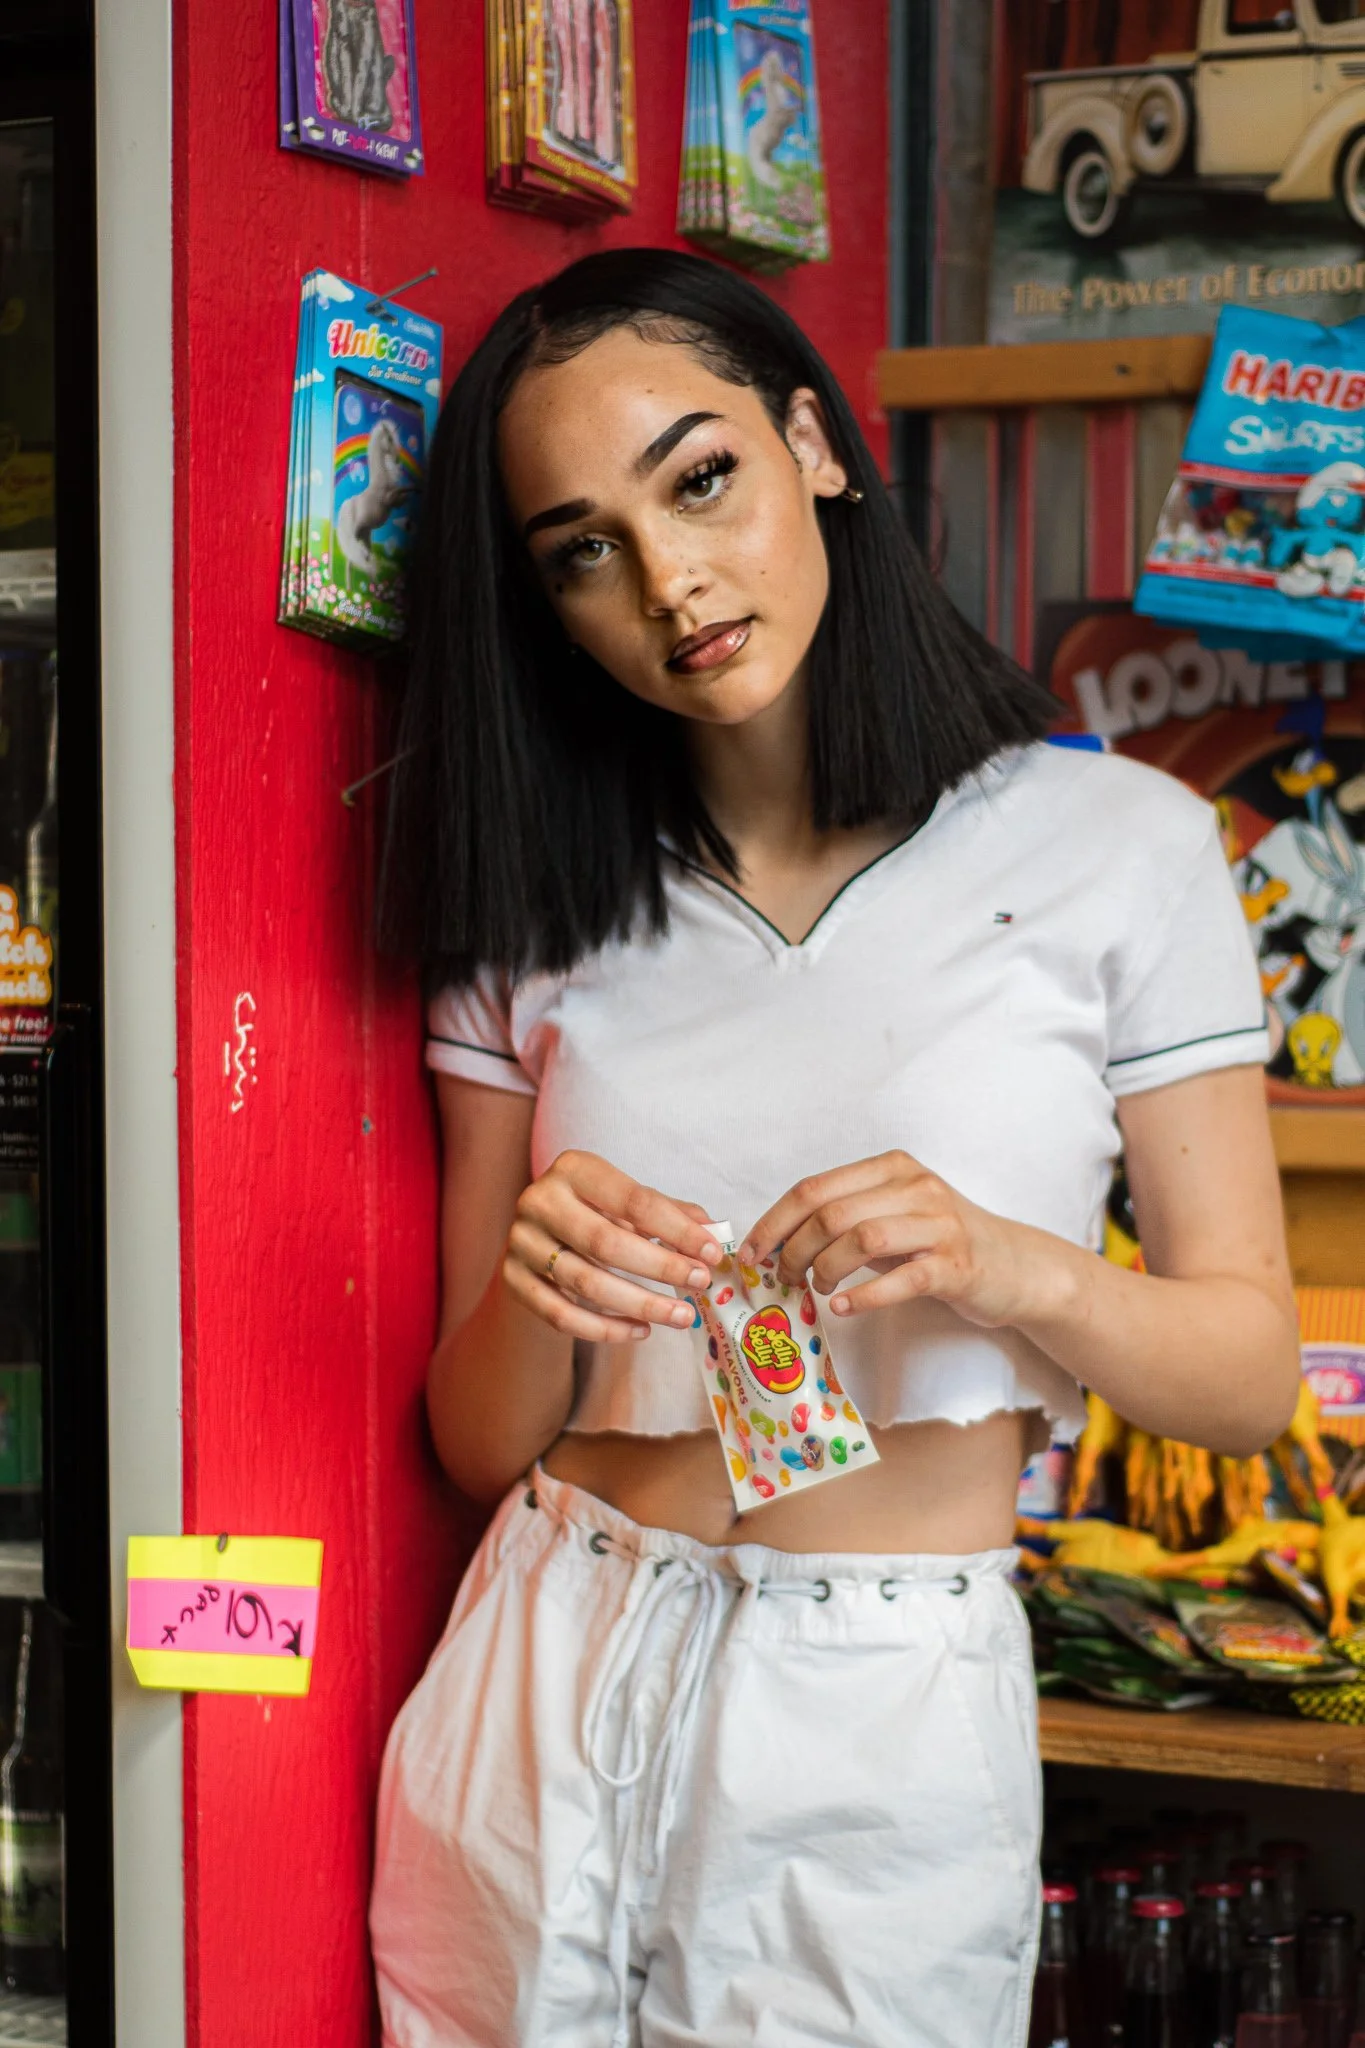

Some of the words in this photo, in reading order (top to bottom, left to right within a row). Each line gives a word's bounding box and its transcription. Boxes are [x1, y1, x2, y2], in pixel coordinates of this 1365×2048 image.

[1013, 280, 1072, 314] The
[1082, 276, 1189, 310] Power
[1202, 263, 1239, 299] of
[327, 318, 428, 370] Unicorn
[716, 1321, 726, 1339] 20
[722, 1343, 748, 1405] FLAVORS
[741, 1324, 774, 1368] Belly
[766, 1328, 801, 1371] Jelly
[160, 1584, 221, 1645] PACK
